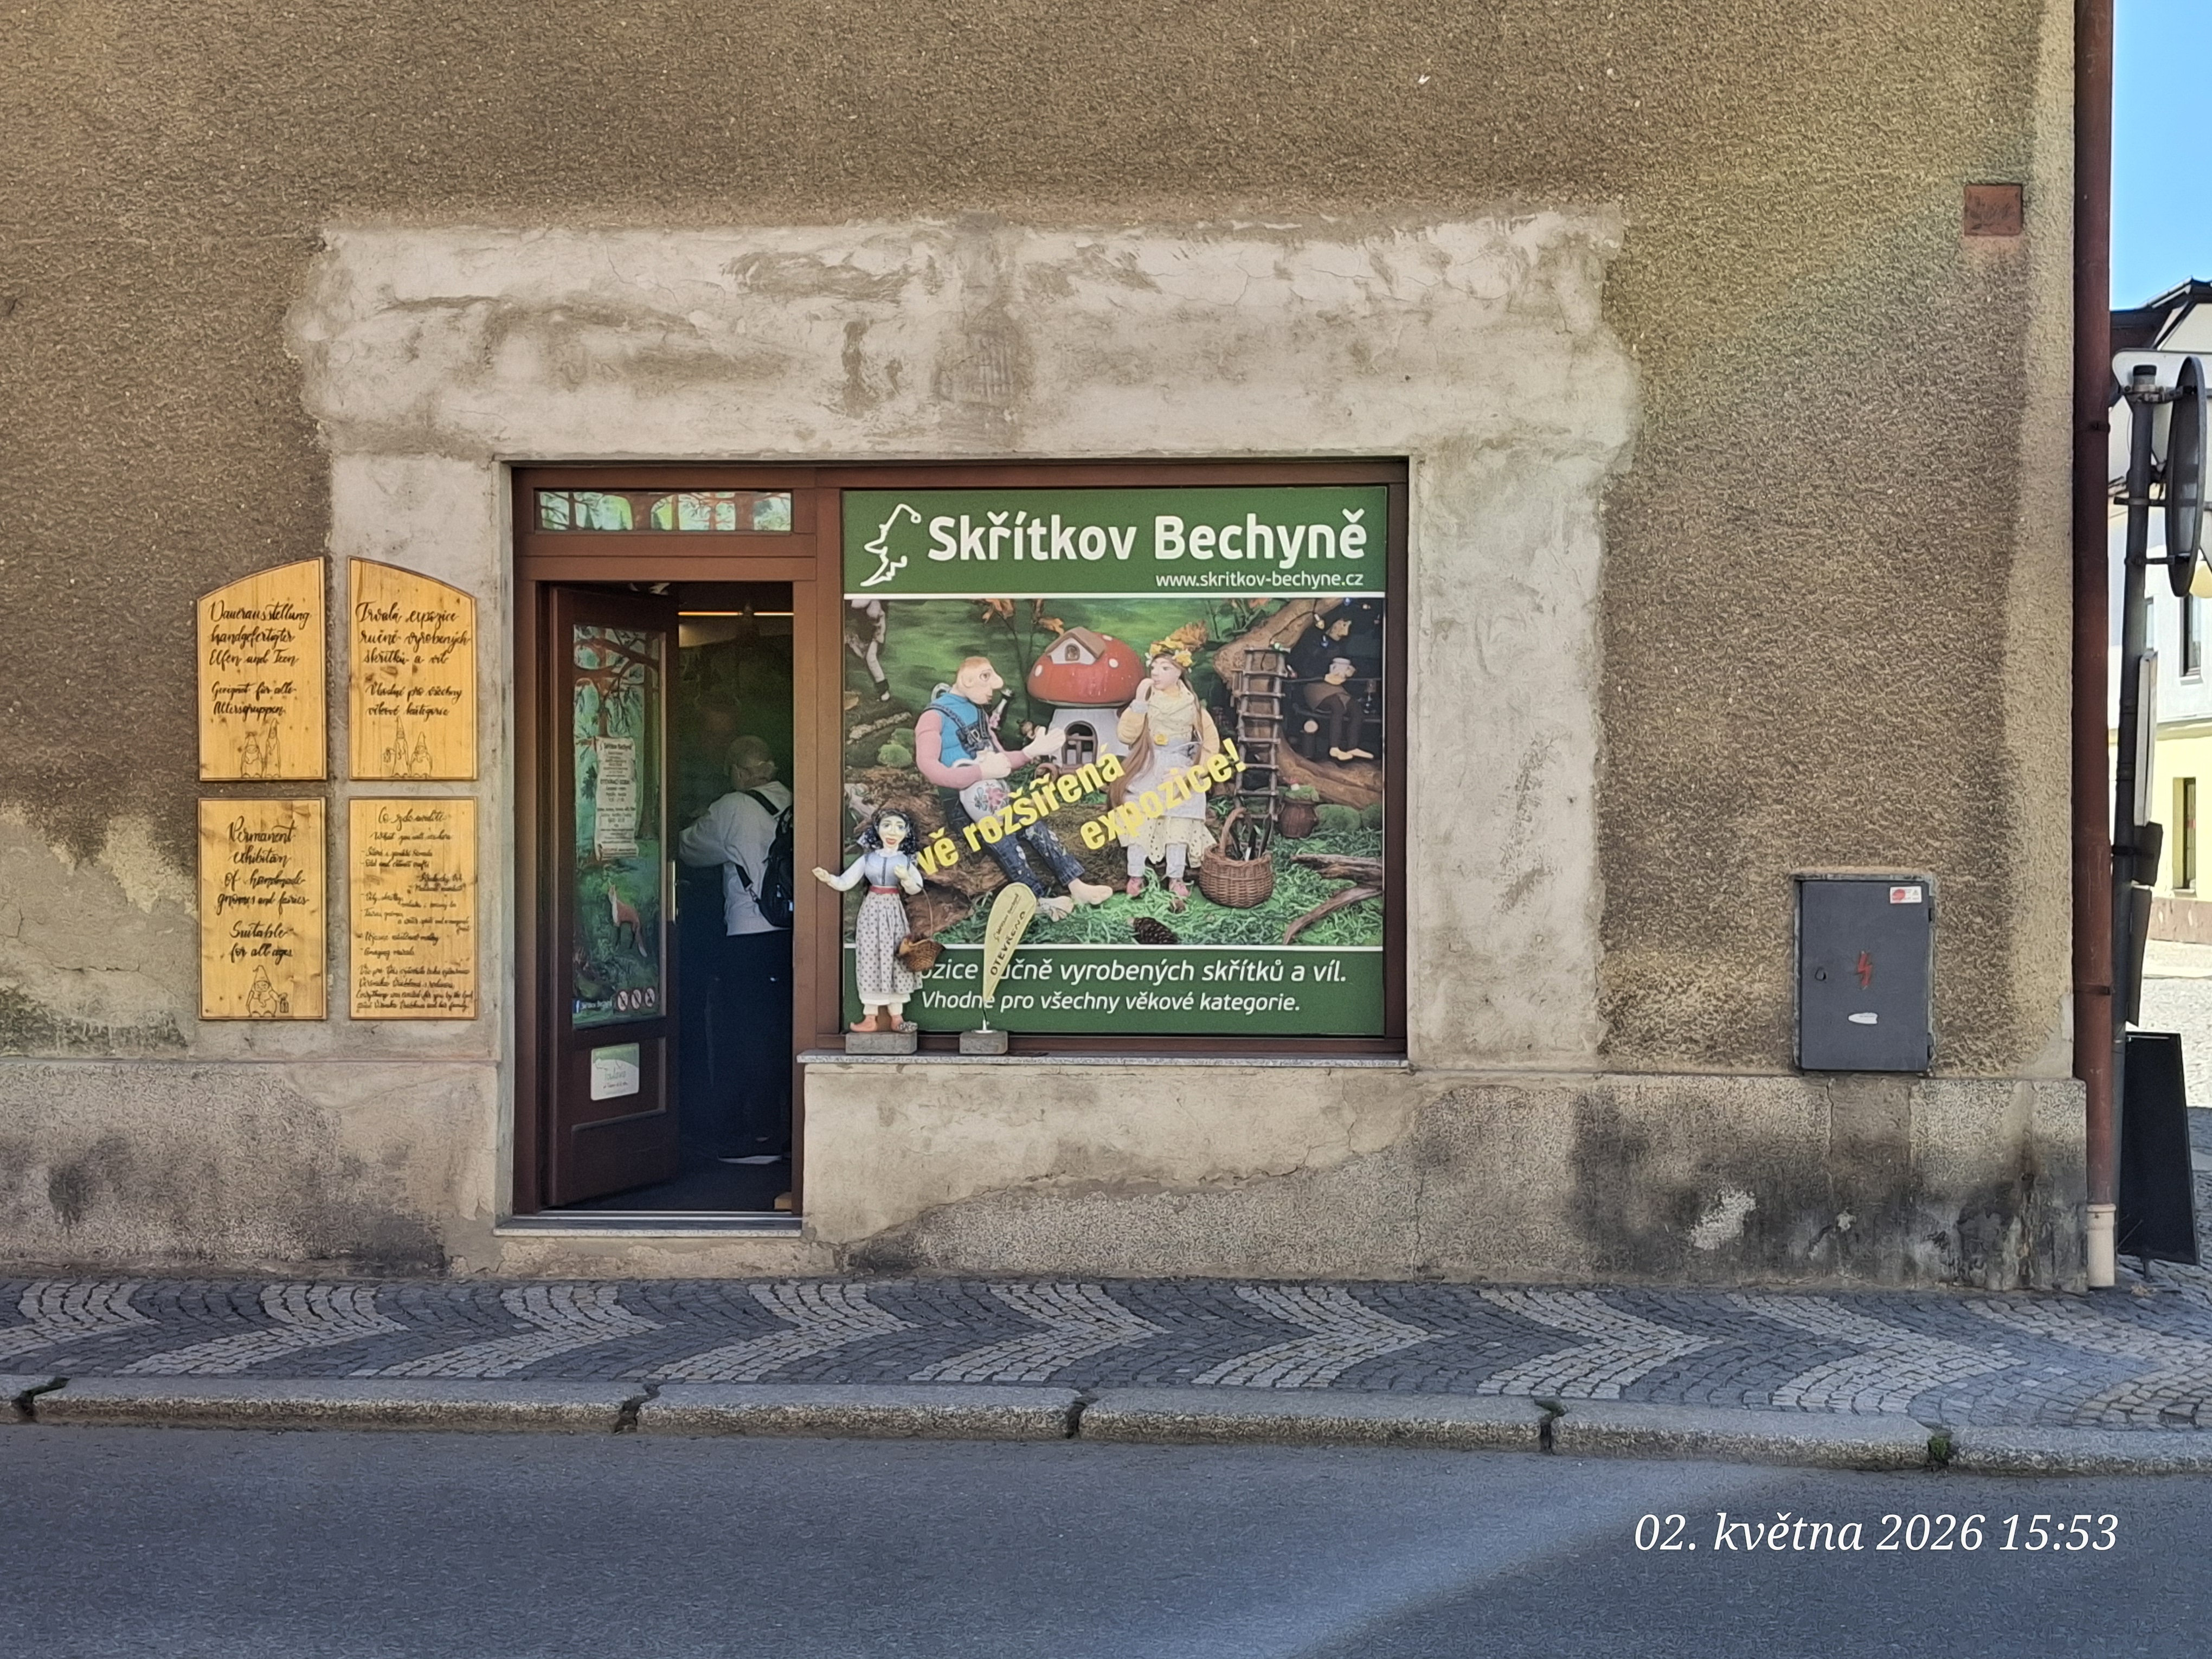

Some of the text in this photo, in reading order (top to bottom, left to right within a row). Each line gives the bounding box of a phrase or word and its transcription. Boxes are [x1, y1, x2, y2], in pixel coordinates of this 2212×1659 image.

[928, 508, 1367, 569] Skřítkov Bechyně
[1155, 571, 1364, 589] www.skritkov-bechyne.cz
[414, 655, 425, 664] a
[1080, 738, 1246, 850] expozice!
[917, 743, 1125, 876] vě rozšířená
[227, 815, 298, 844] Permanent
[229, 920, 288, 938] Suitable
[230, 942, 247, 963] for
[999, 958, 1052, 980] učně
[1060, 959, 1194, 986] vyrobených
[1201, 959, 1284, 982] skřítků
[1290, 964, 1305, 982] a
[1314, 959, 1347, 982] víl.
[1000, 995, 1034, 1013] pro
[1040, 991, 1121, 1014] všechny
[1126, 991, 1194, 1010] věkové
[1200, 992, 1300, 1015] kategorie.
